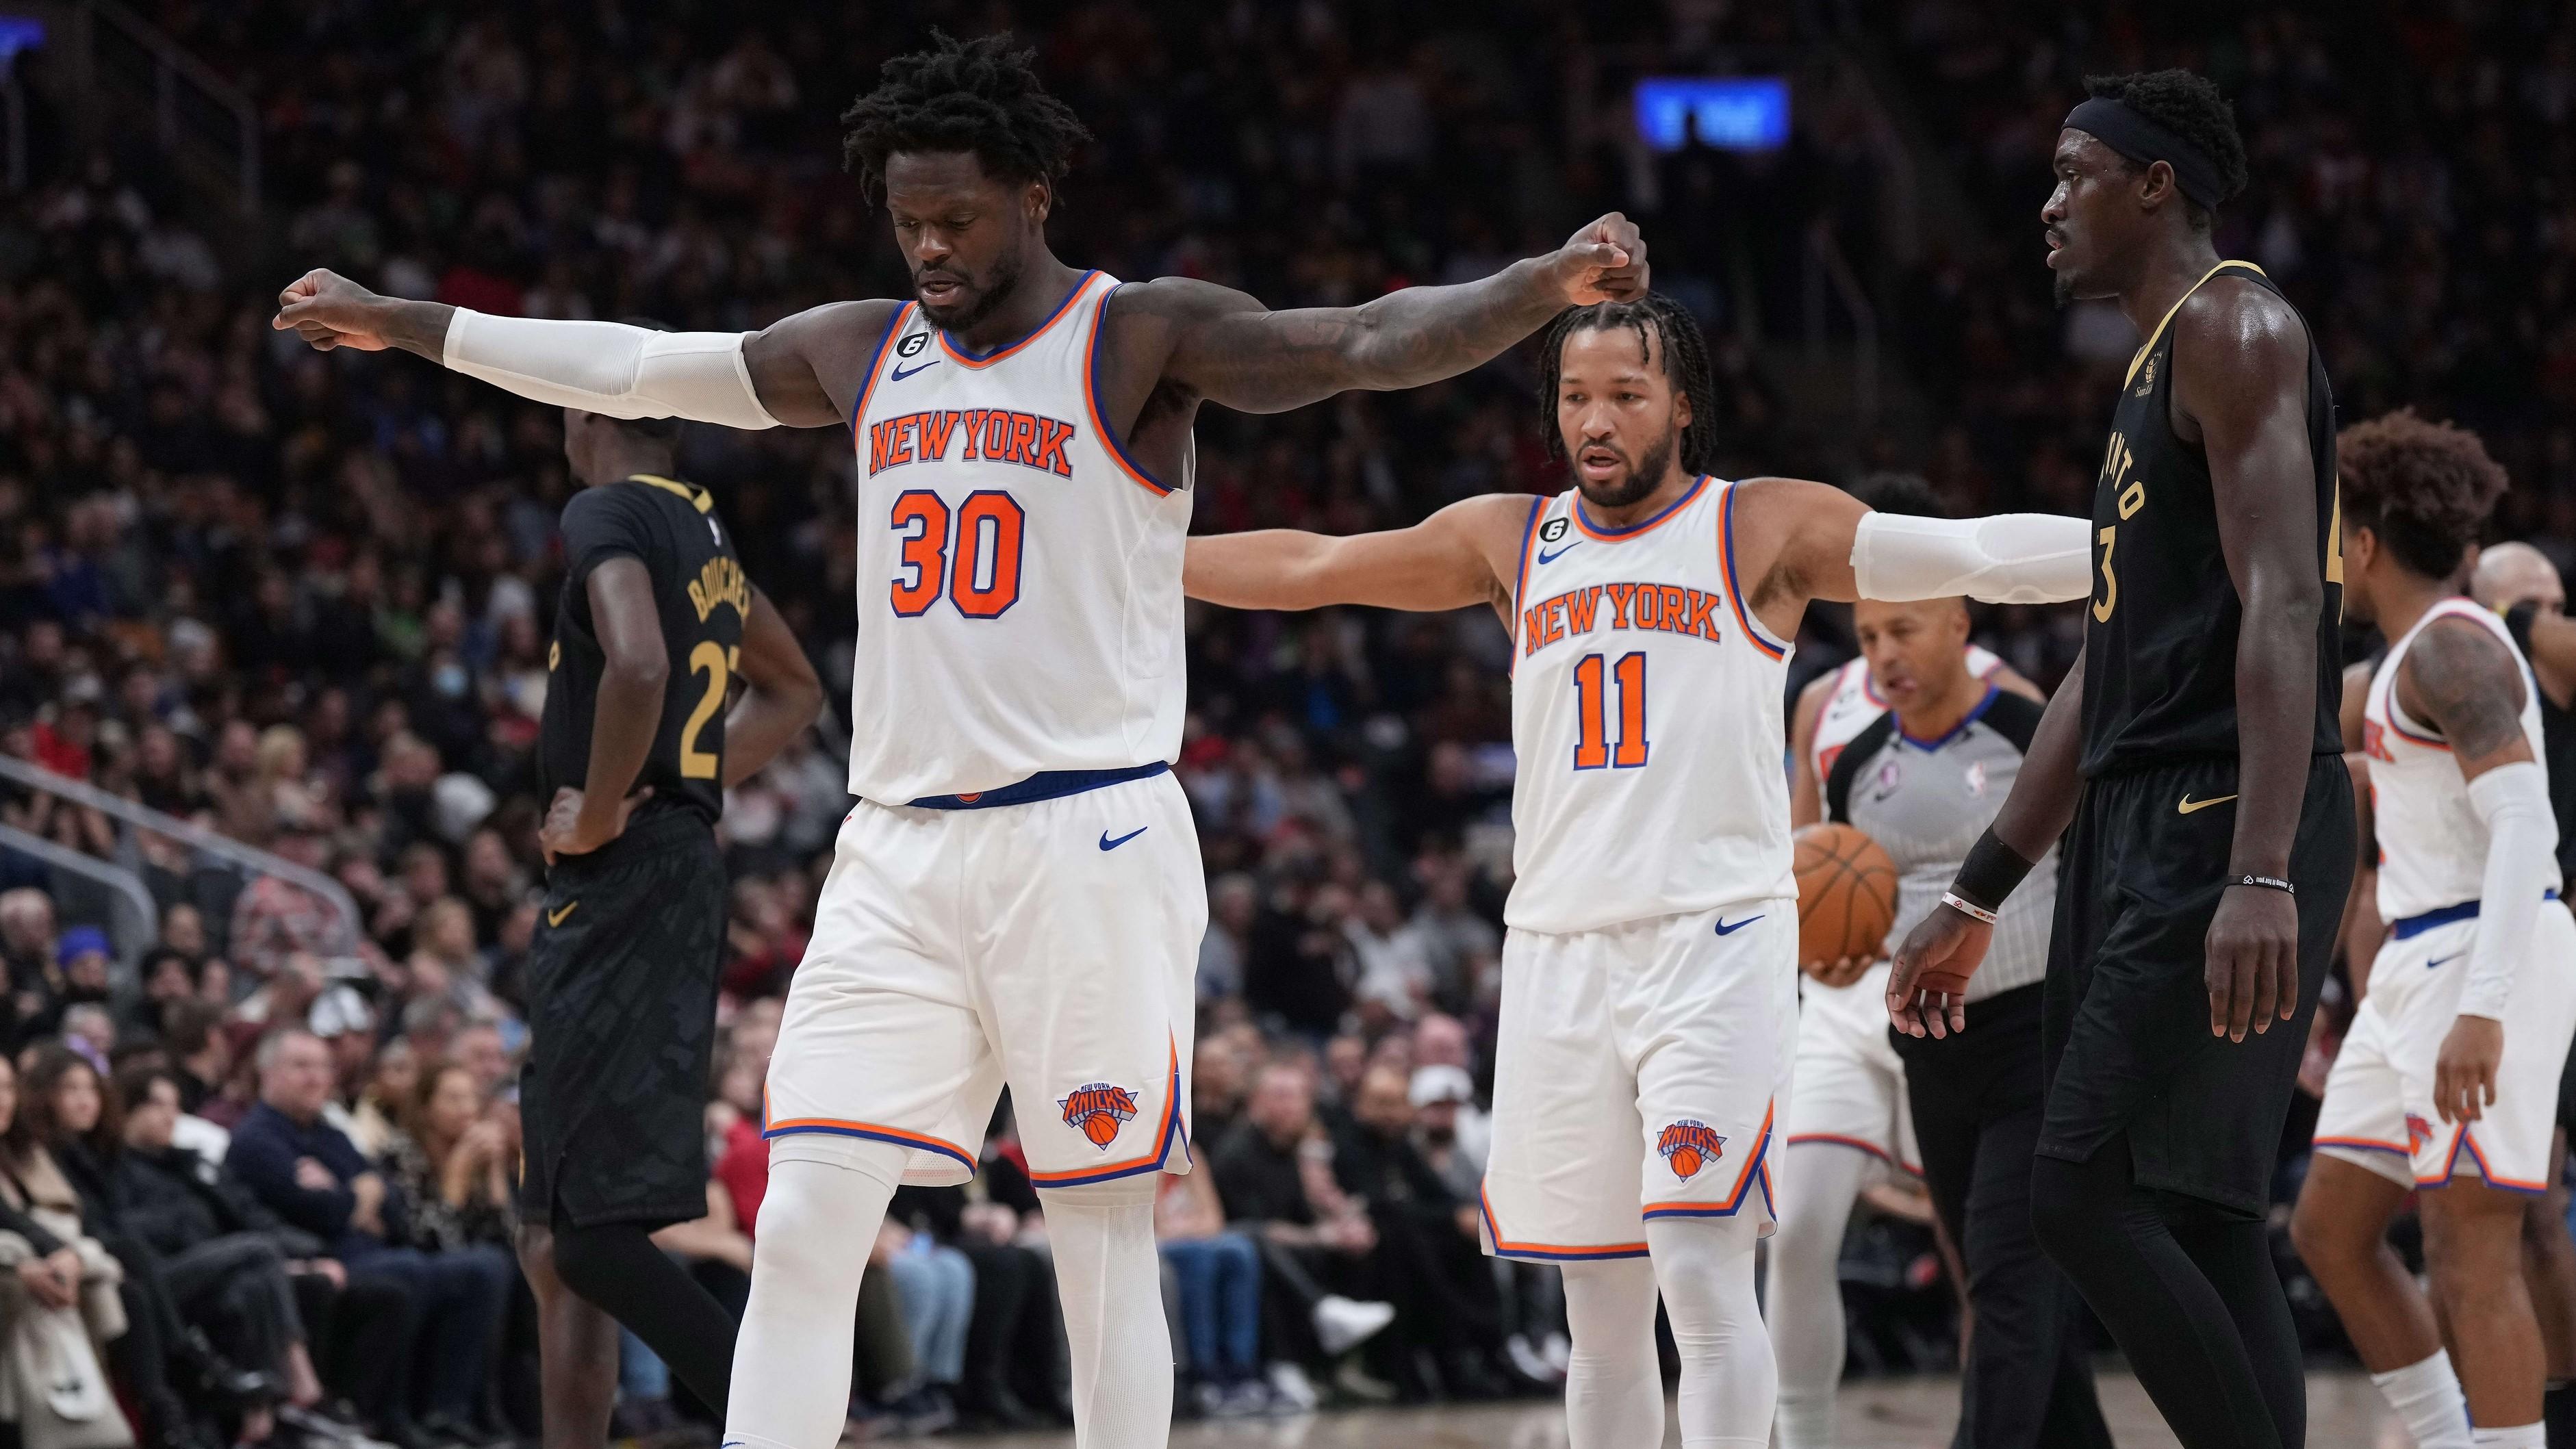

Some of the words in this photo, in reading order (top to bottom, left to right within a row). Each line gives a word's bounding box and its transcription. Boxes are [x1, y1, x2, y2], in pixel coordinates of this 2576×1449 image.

[907, 338, 921, 352] 6
[869, 410, 960, 479] NEW
[960, 409, 1075, 480] YORK
[1548, 520, 1565, 541] 6
[890, 489, 1025, 619] 30
[2092, 524, 2117, 624] 3
[1524, 584, 1602, 658] NEW
[1605, 582, 1721, 645] YORK
[1573, 651, 1650, 771] 11
[1062, 1086, 1138, 1123] KNICKS
[1080, 1083, 1093, 1092] NEW
[1657, 1124, 1723, 1157] KNICKS
[1689, 1119, 1705, 1129] YORK
